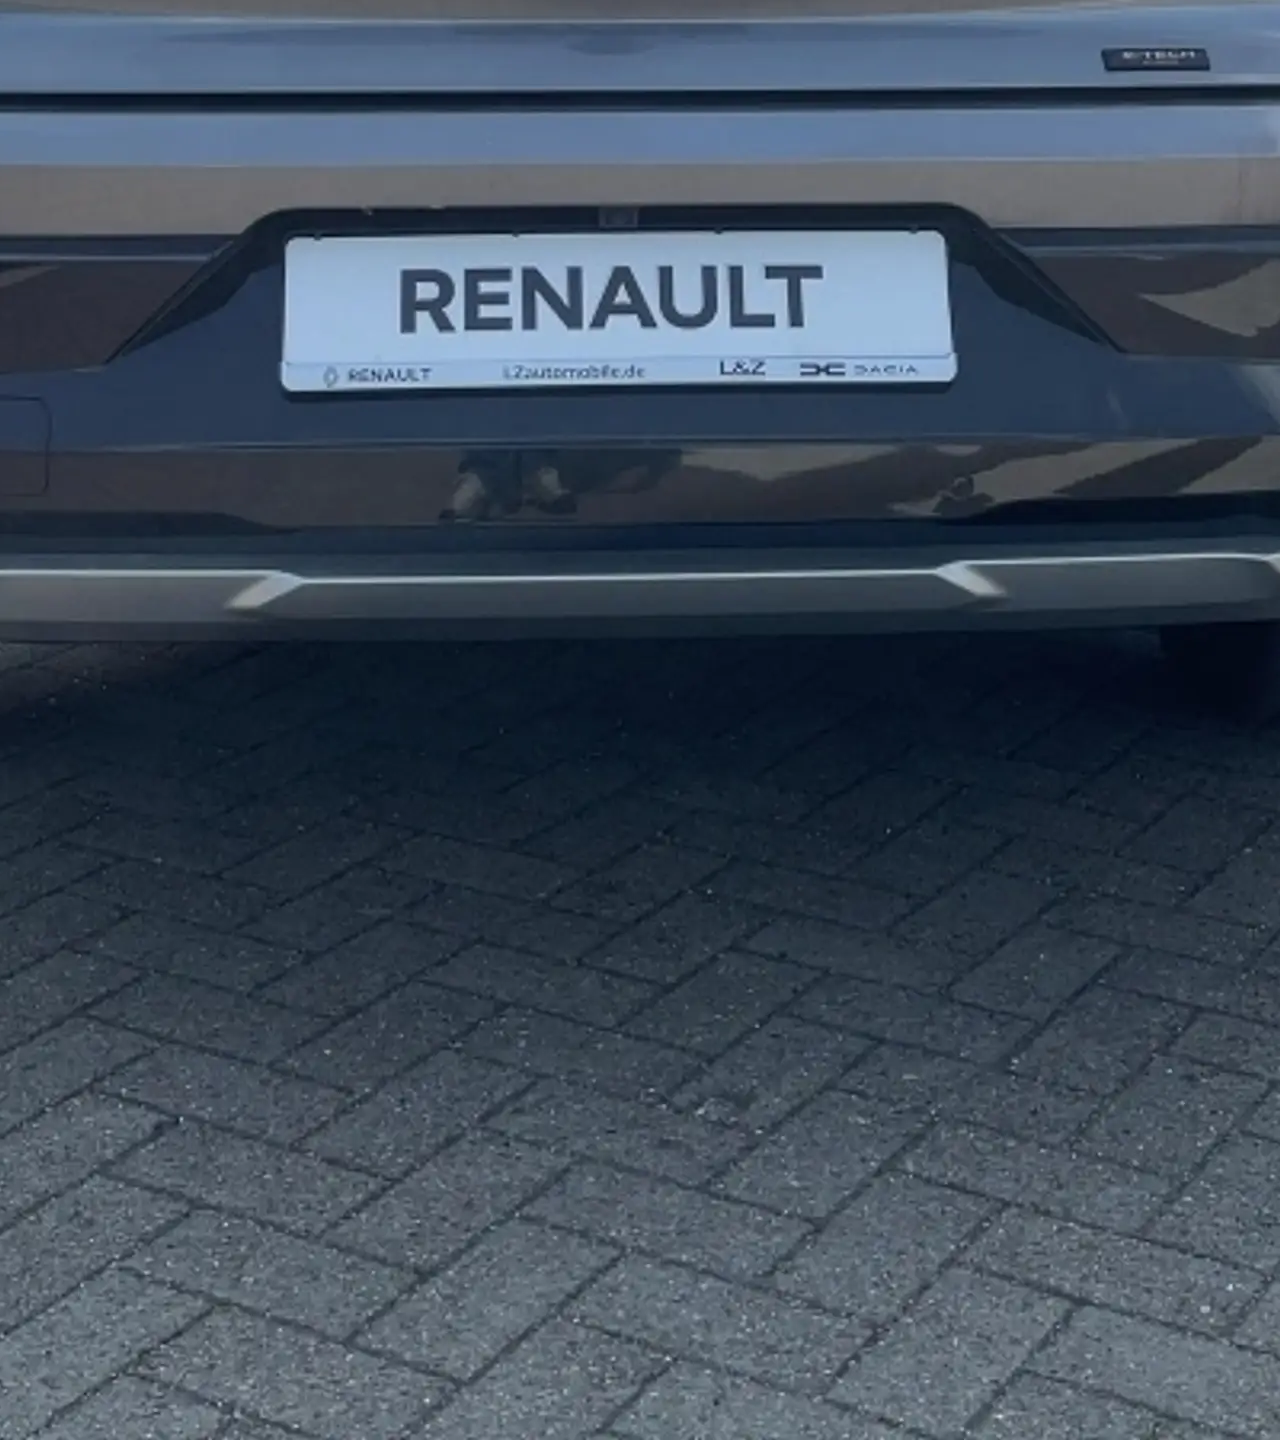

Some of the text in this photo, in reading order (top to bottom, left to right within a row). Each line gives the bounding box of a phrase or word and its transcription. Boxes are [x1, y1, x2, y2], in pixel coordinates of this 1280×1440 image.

[399, 265, 824, 333] RENAULT
[347, 367, 432, 383] RENAULT
[719, 360, 766, 376] L&Z
[854, 364, 918, 376] DACIA
